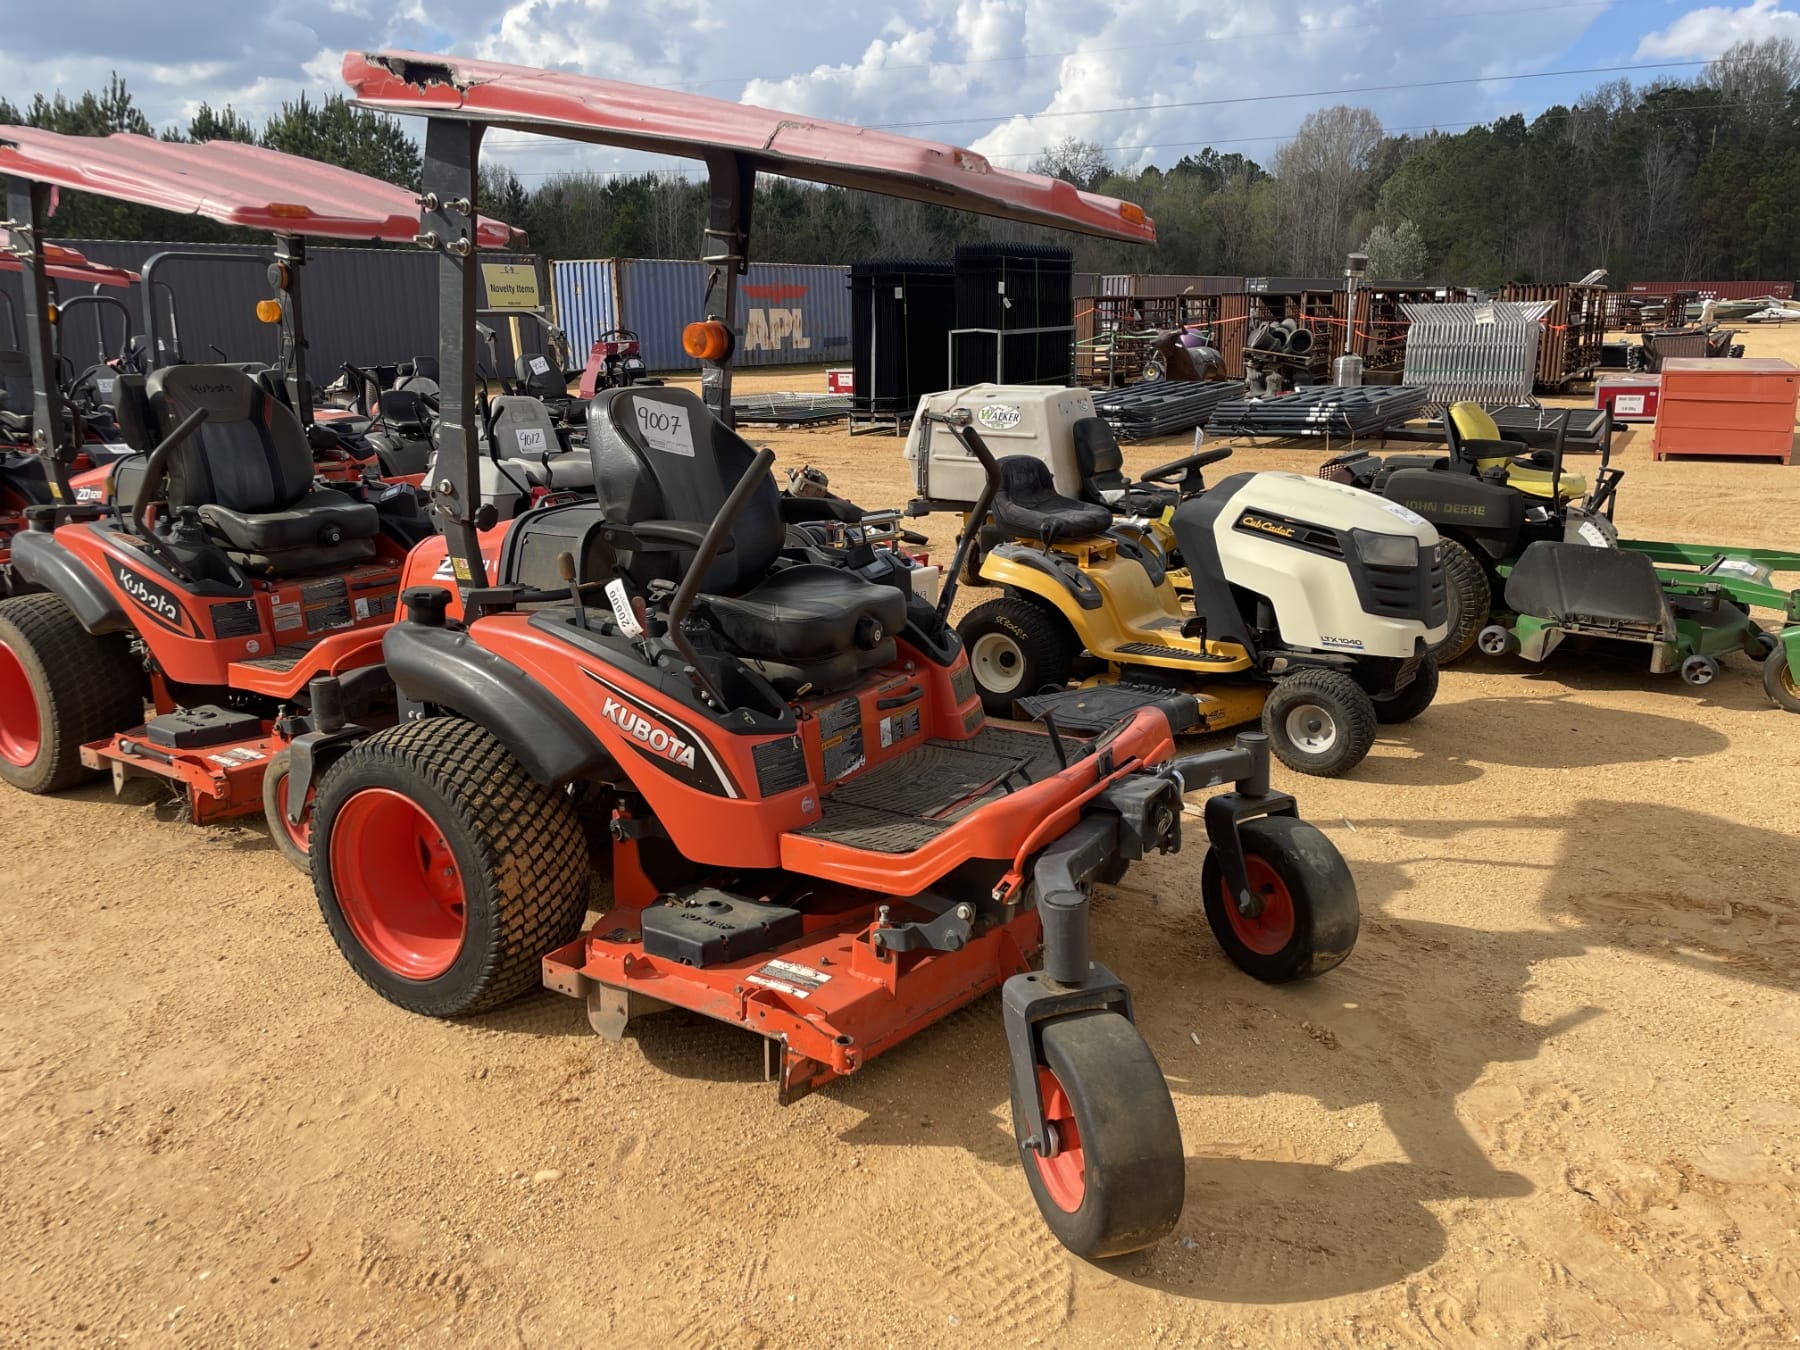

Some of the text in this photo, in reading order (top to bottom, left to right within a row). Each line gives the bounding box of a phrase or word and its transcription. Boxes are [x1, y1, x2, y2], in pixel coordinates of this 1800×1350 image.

[490, 283, 535, 295] Novelty Items
[744, 308, 810, 351] APL
[638, 406, 682, 435] 9007
[981, 409, 1019, 421] WALKER
[520, 432, 541, 446] 9012
[1444, 503, 1487, 516] DEERE
[1242, 516, 1296, 537] Cub Cadet
[120, 568, 177, 619] Kubota
[601, 697, 696, 770] KUBOTA
